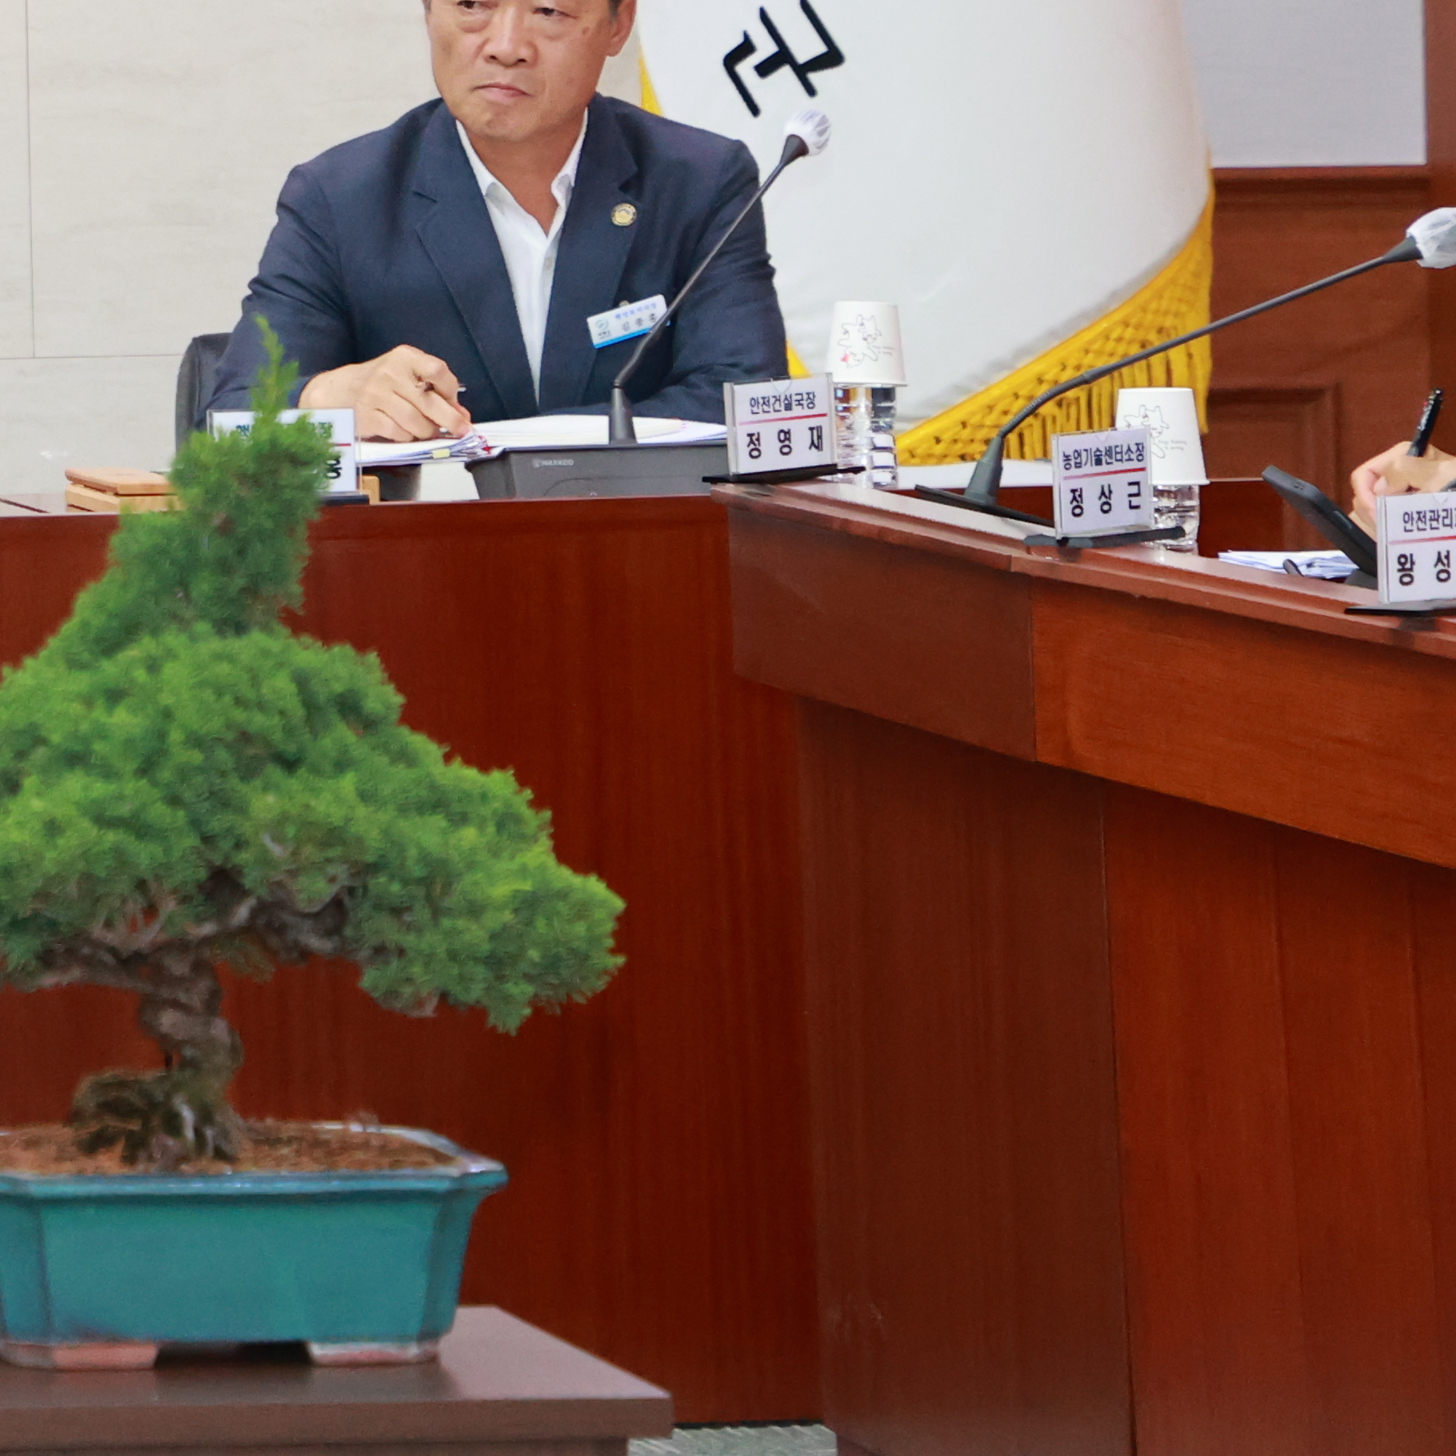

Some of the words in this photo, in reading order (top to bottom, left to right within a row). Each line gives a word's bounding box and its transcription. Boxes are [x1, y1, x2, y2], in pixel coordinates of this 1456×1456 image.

[749, 391, 816, 414] 안전건설국장
[1062, 442, 1145, 470] 농업기술센터소장
[1402, 506, 1456, 533] 안전관리
